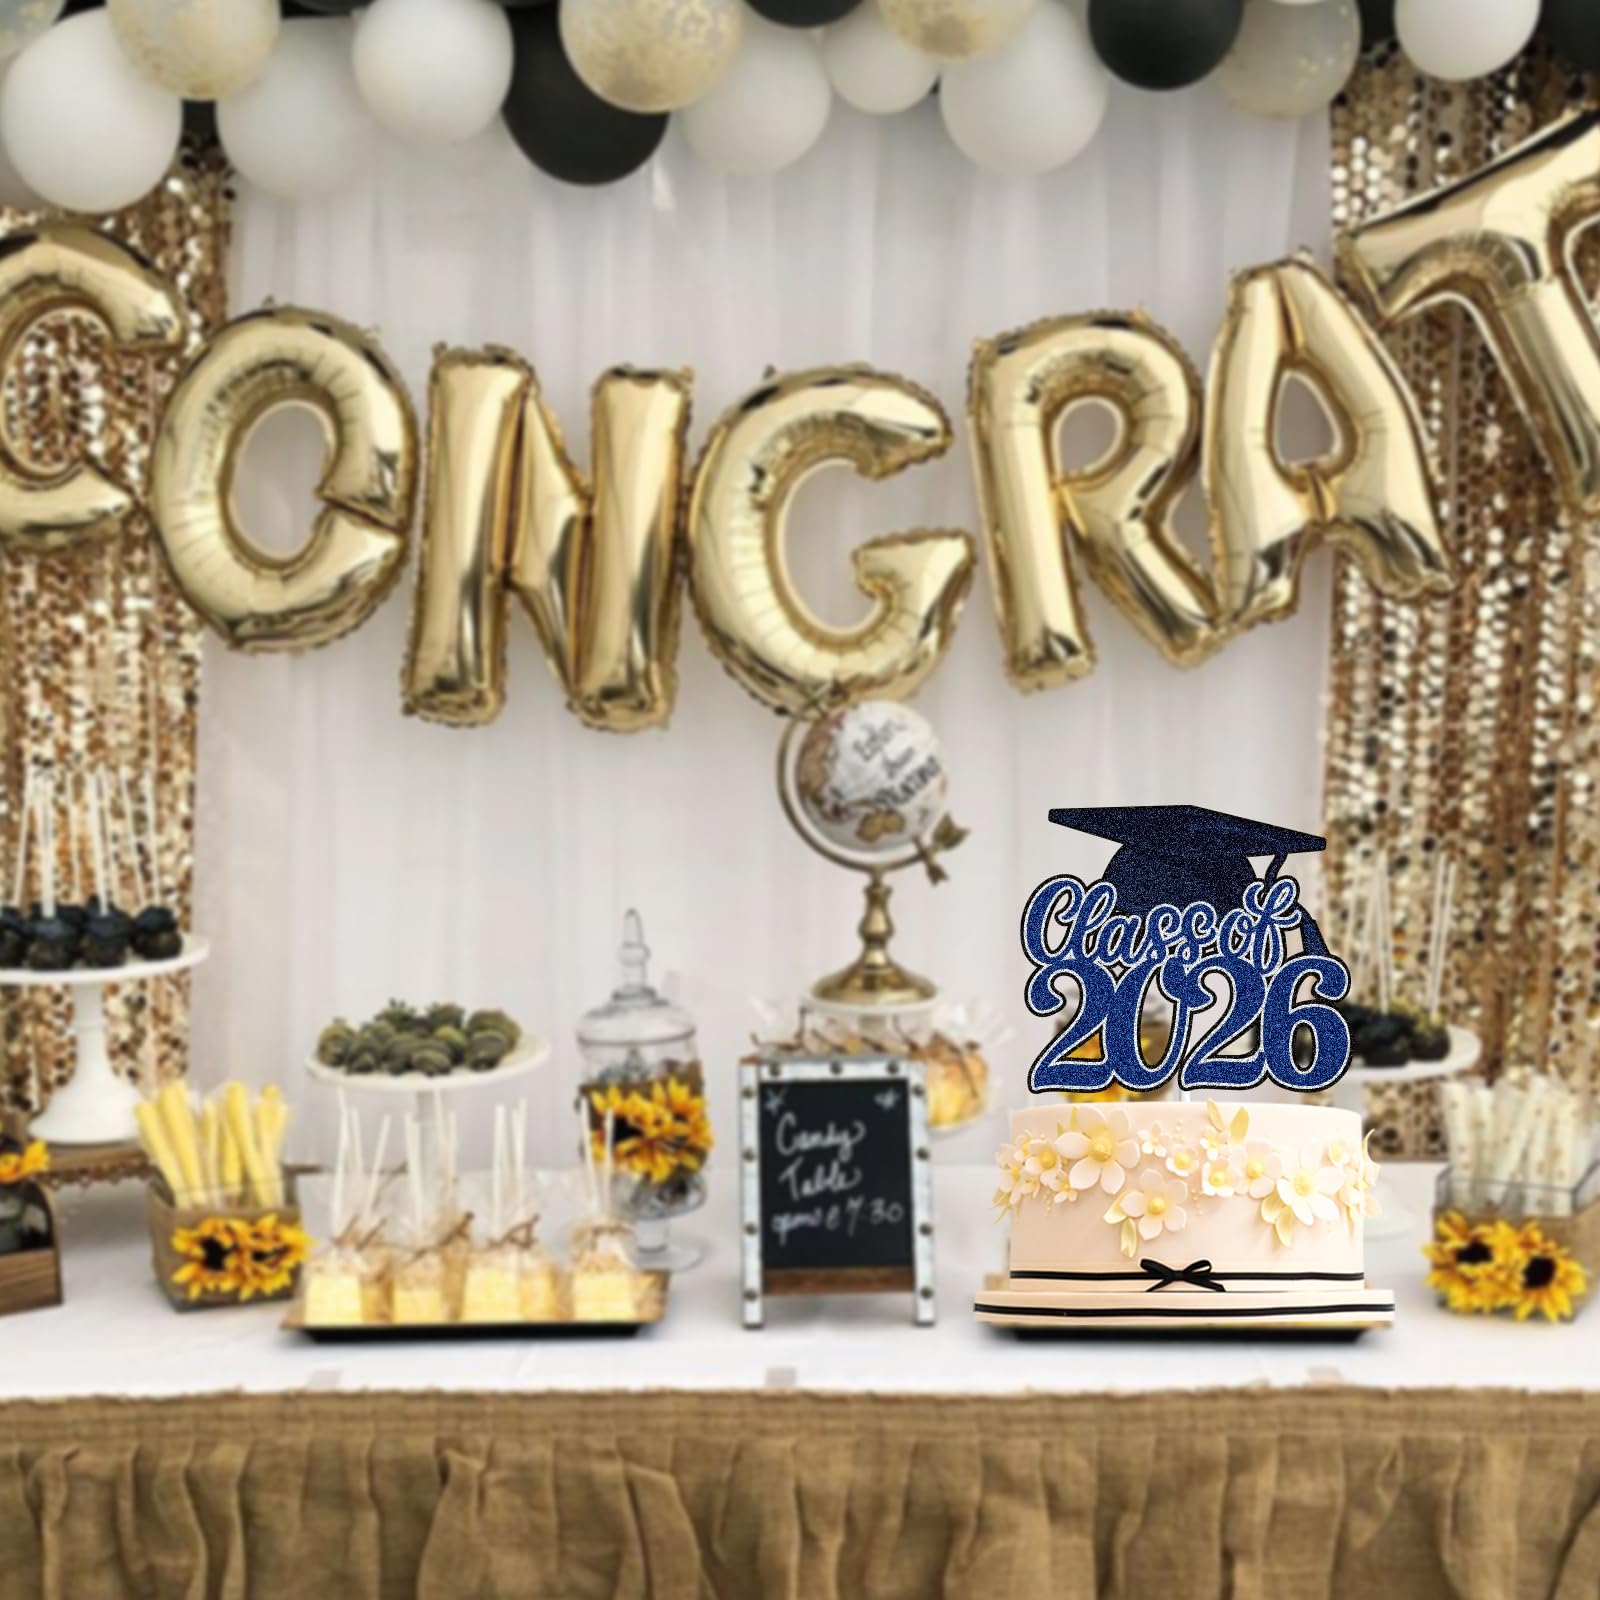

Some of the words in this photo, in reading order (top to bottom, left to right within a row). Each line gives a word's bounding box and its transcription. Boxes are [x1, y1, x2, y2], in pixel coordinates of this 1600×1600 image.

[1021, 874, 1217, 970] Class
[1215, 876, 1302, 974] of
[1023, 952, 1352, 1093] 2026
[775, 1111, 866, 1163] Candy
[778, 1156, 862, 1201] Table
